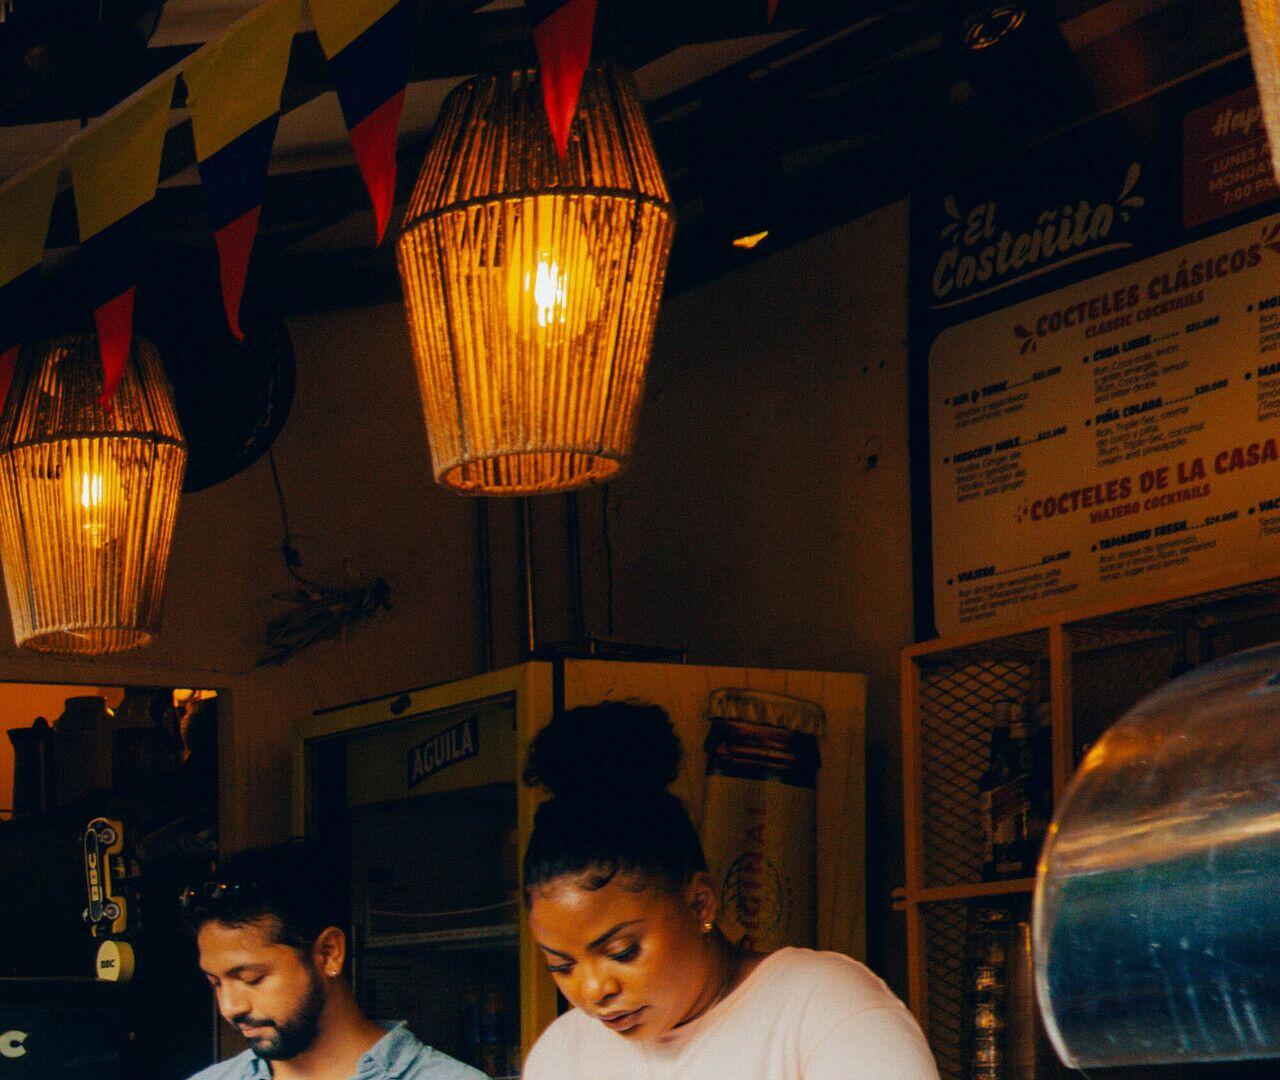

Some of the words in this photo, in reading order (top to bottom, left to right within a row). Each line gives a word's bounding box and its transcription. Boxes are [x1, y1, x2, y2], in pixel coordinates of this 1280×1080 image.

[963, 201, 995, 246] El
[932, 201, 1113, 297] Costeñito
[1035, 284, 1138, 337] COCTELES
[1148, 243, 1261, 299] CLÁSICOS
[1084, 314, 1132, 338] CLASSIC
[1136, 290, 1204, 321] COCKTAILS
[1030, 476, 1131, 521] COCTELES
[1139, 466, 1169, 494] DE
[1178, 457, 1205, 484] LA
[1214, 438, 1278, 475] CASA
[1090, 501, 1139, 524] VIAJERO
[1144, 483, 1210, 511] COCKTAILS
[100, 959, 116, 969] BBC
